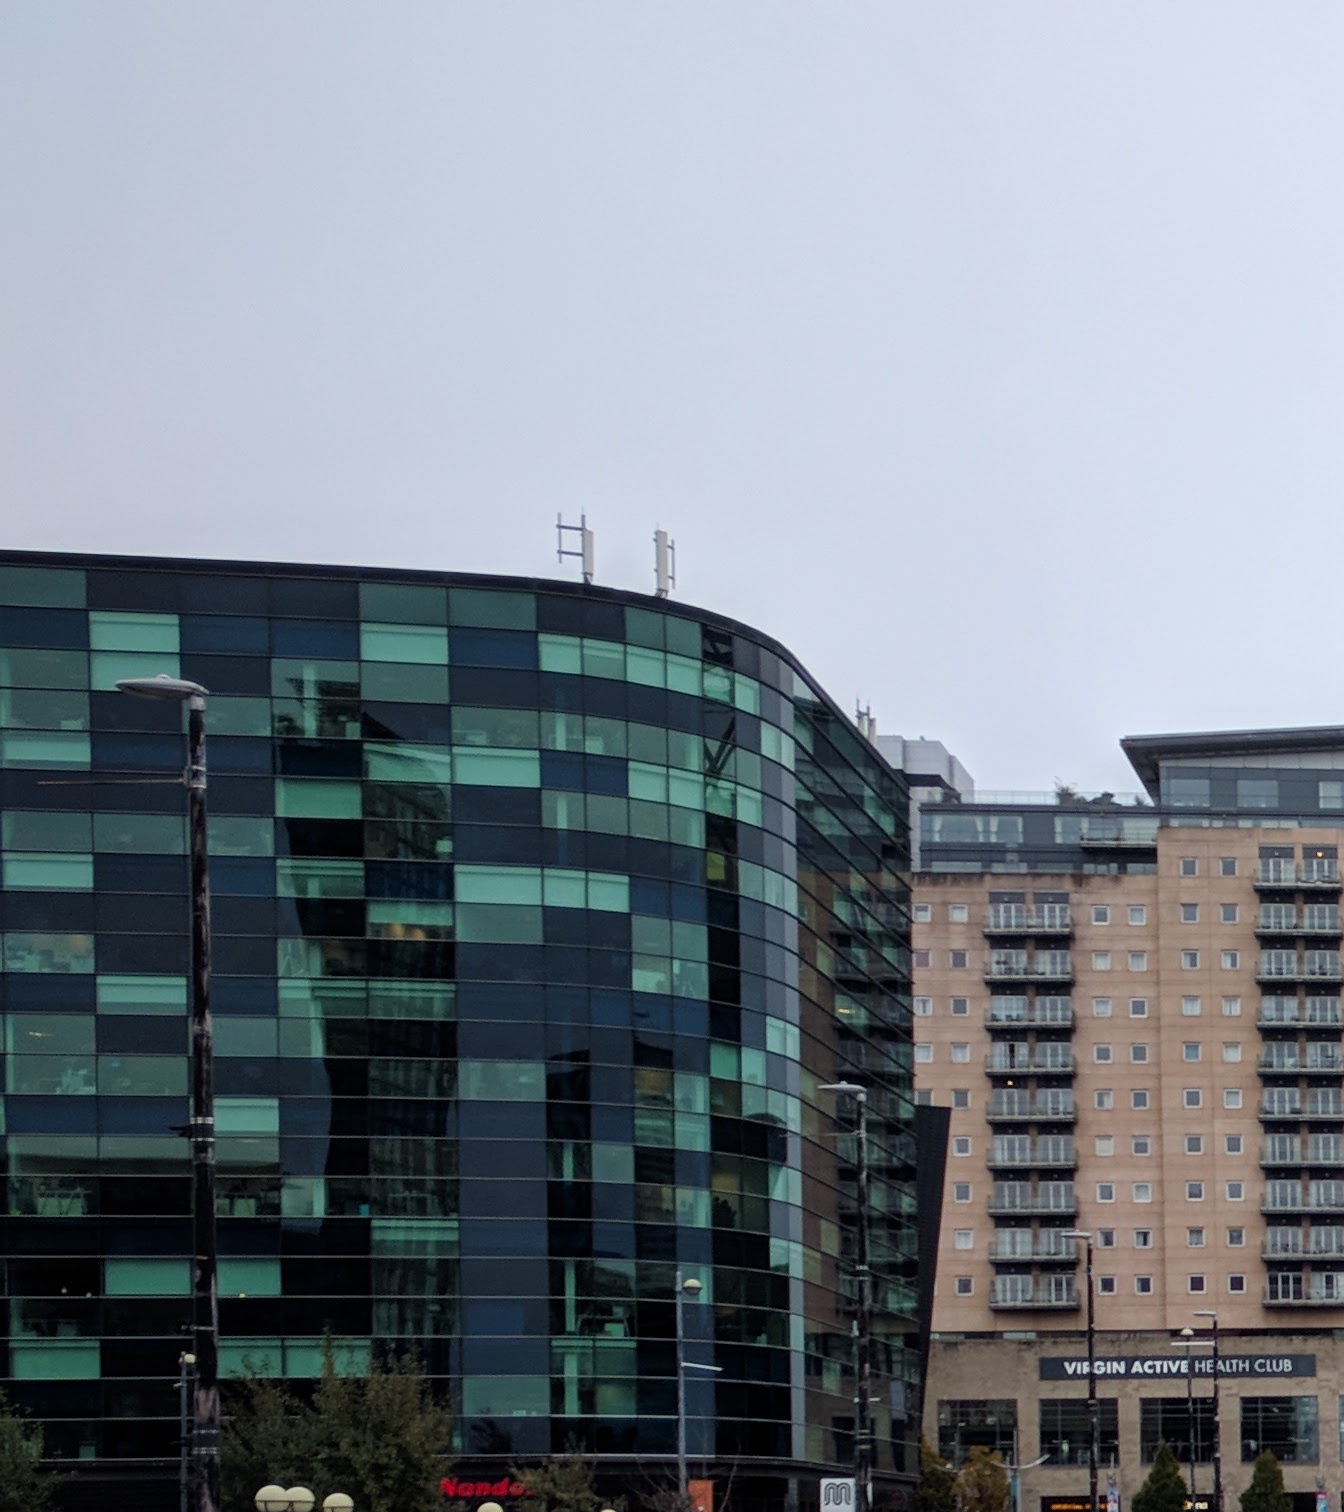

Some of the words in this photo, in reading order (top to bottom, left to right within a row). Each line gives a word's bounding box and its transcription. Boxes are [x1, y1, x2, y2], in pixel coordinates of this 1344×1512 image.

[1063, 1361, 1126, 1375] VIRGIN
[1130, 1360, 1189, 1375] ACTIVE
[1194, 1359, 1250, 1373] HEALTH
[1254, 1358, 1293, 1373] CLUB
